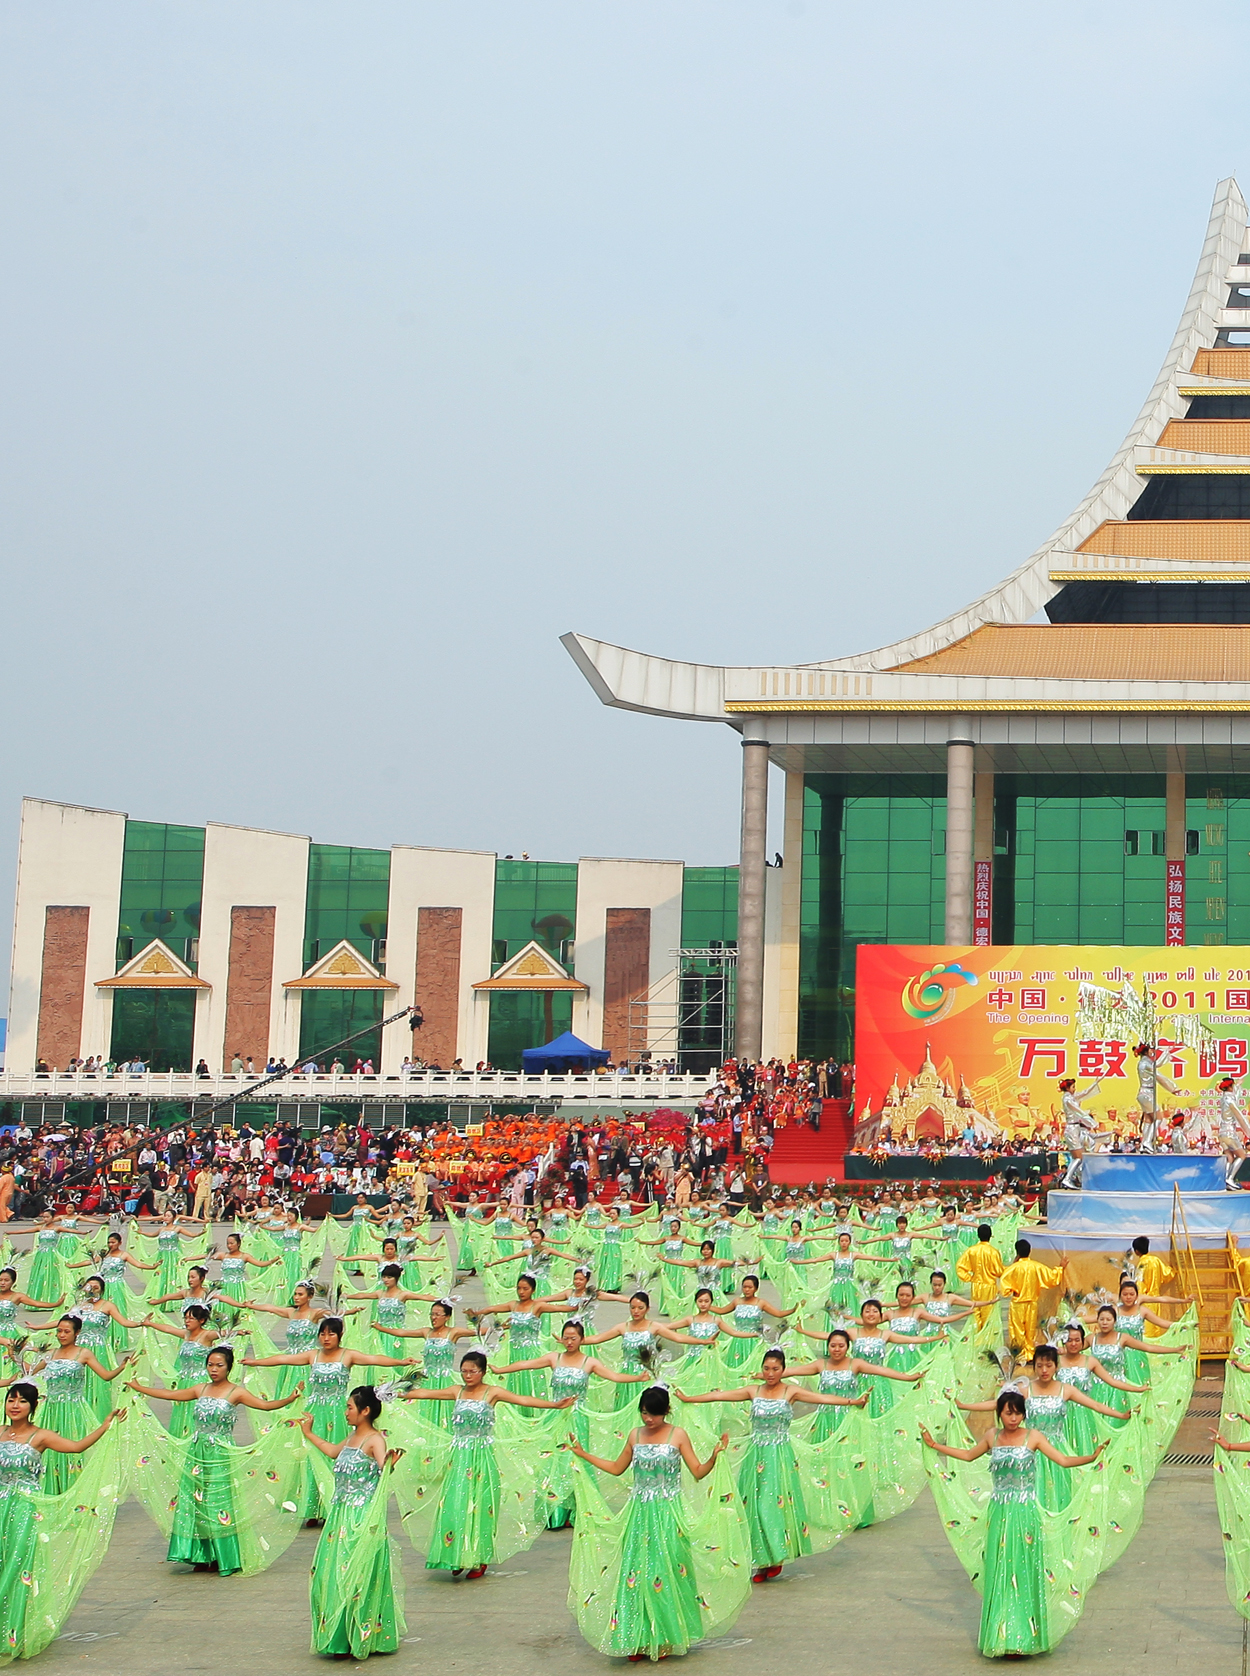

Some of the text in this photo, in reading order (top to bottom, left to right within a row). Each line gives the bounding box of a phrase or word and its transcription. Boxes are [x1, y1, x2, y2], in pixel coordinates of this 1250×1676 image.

[1168, 865, 1183, 946] 弘扬民族文
[988, 1013, 1010, 1023] The
[1018, 1013, 1069, 1025] Opening
